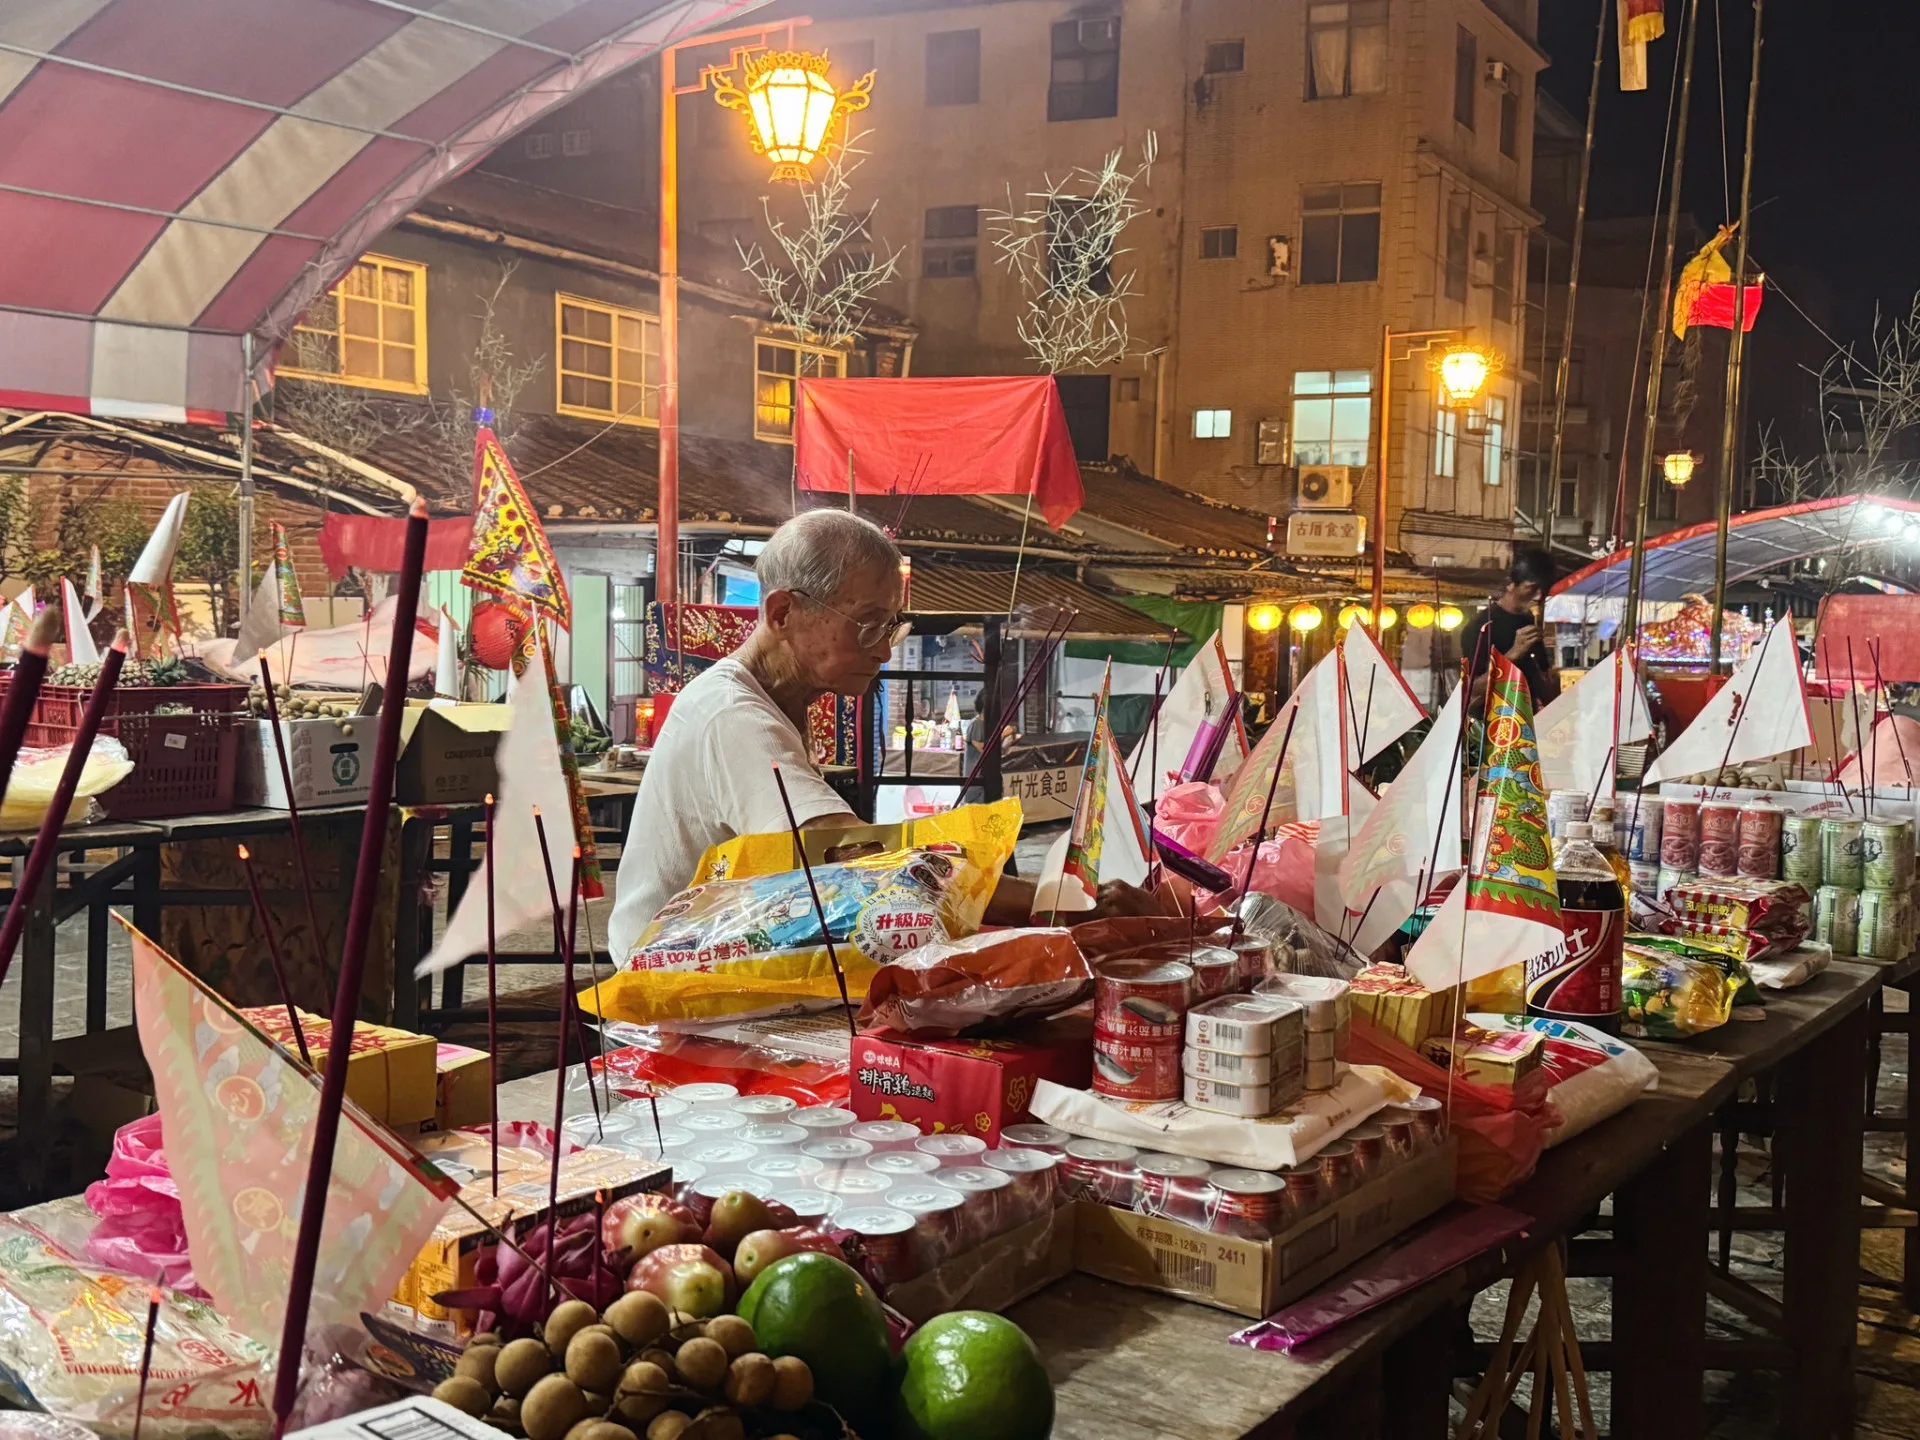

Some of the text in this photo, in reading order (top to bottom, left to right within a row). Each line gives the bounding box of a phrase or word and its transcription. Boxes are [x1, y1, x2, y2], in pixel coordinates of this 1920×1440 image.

[1009, 770, 1068, 799] 竹光食品
[876, 912, 935, 931] 升級版
[892, 932, 918, 950] 2.0
[1217, 1245, 1246, 1266] 2411
